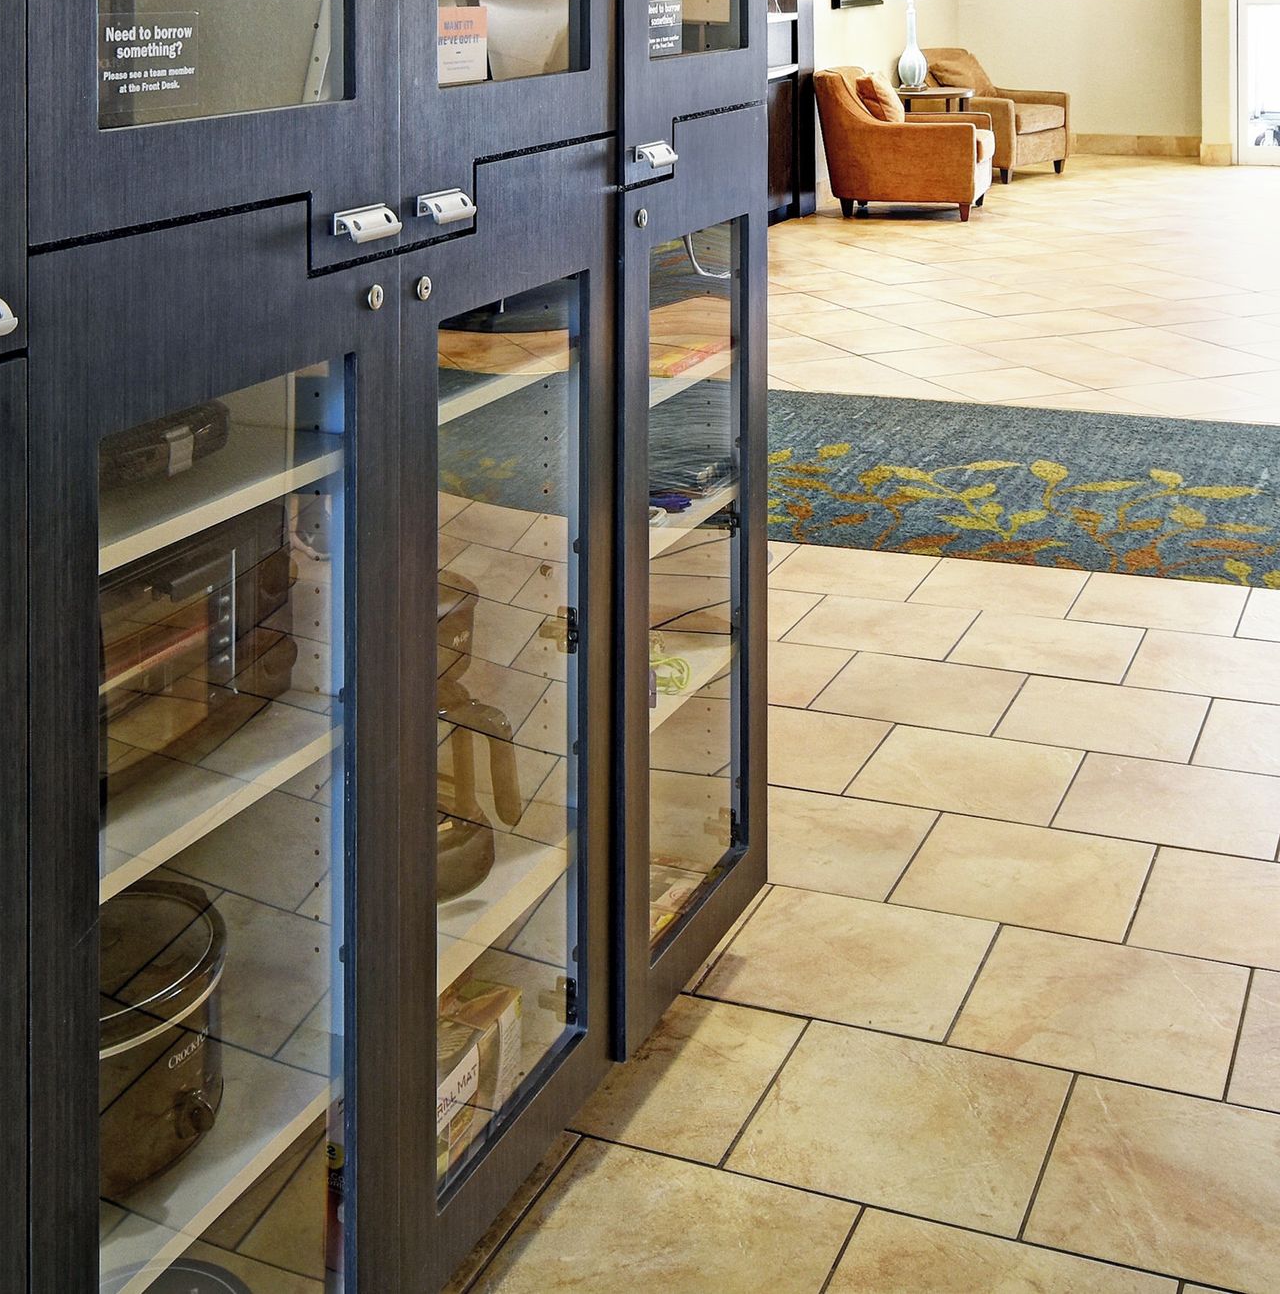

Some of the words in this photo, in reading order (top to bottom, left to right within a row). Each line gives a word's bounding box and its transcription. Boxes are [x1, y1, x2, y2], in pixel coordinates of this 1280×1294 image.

[105, 26, 136, 42] Need
[139, 26, 151, 40] to
[154, 25, 193, 40] borrow
[116, 41, 183, 59] something?
[103, 71, 128, 81] Please
[129, 71, 142, 79] see
[143, 70, 148, 78] a
[150, 68, 167, 77] team
[168, 66, 195, 76] member
[119, 84, 127, 94] at
[128, 83, 140, 93] the
[142, 81, 160, 92] Front
[161, 79, 181, 90] Desk.
[457, 1063, 477, 1094] MAT
